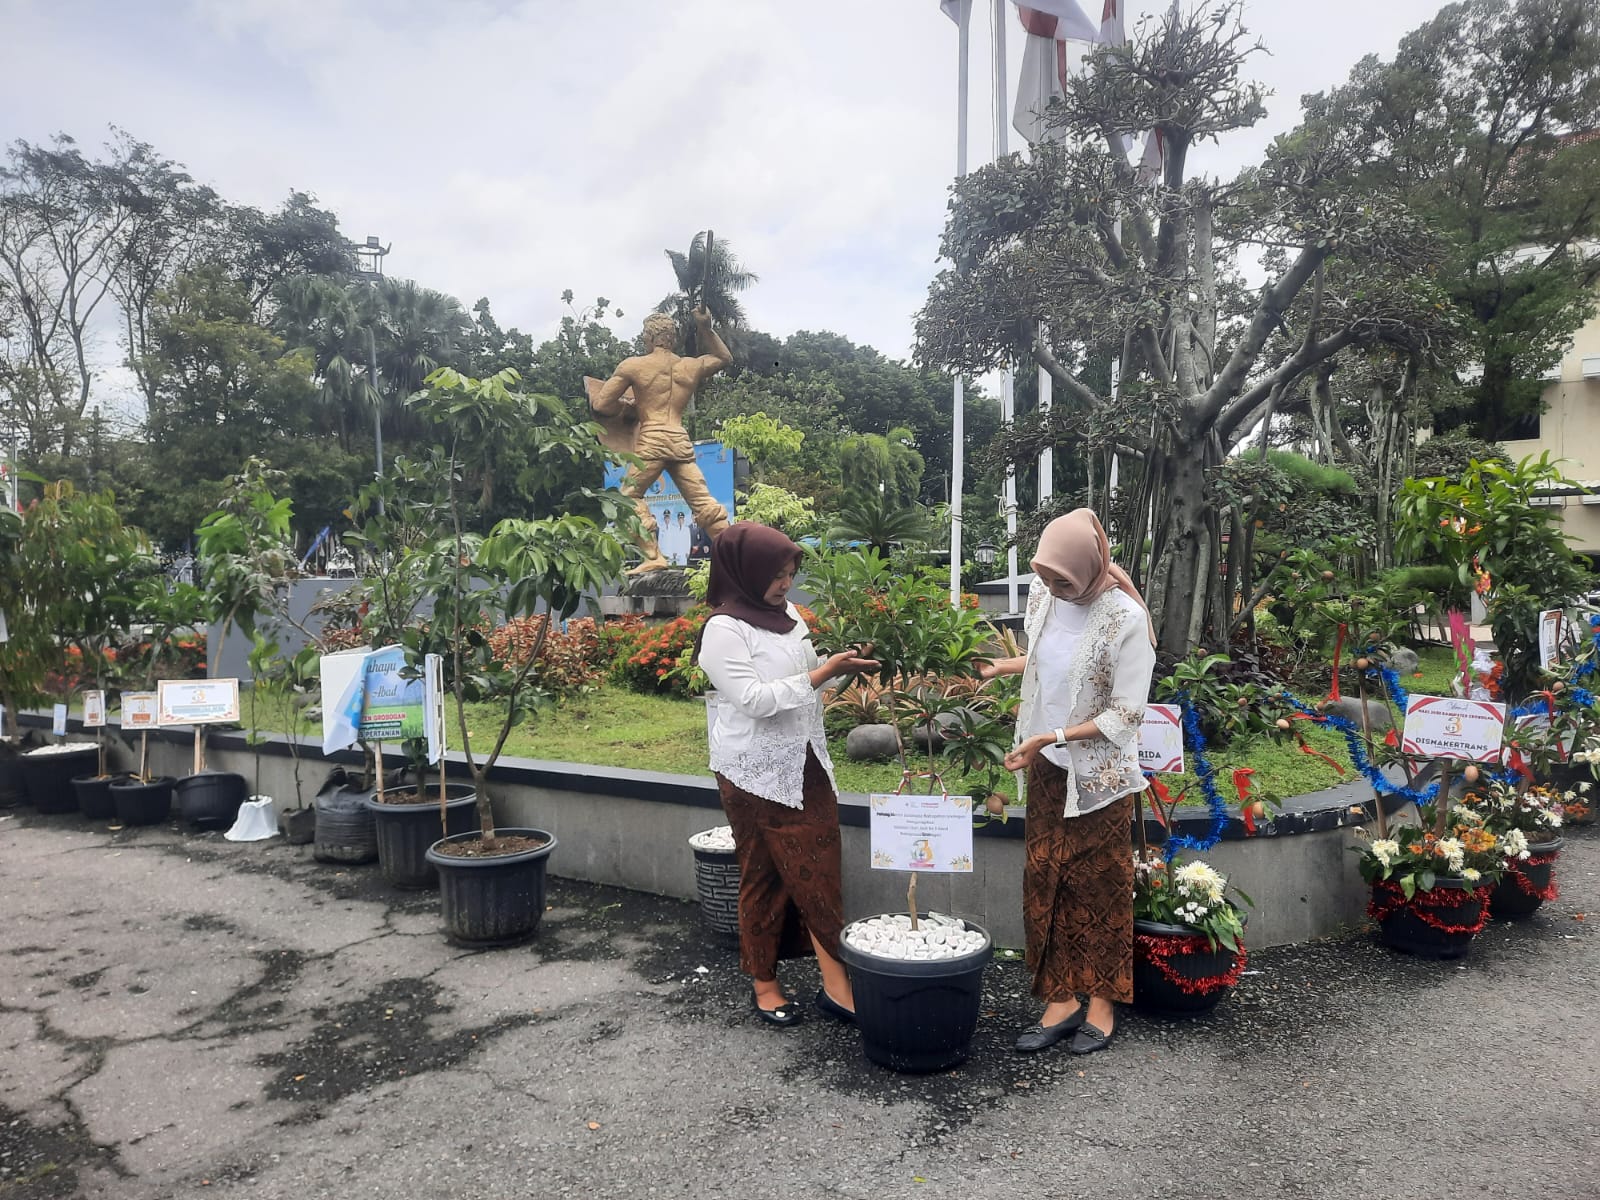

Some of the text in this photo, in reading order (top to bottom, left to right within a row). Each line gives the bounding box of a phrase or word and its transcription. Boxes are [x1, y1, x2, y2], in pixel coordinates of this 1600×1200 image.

[366, 660, 397, 676] ahayu
[365, 729, 400, 738] PERTANIAN
[1138, 750, 1161, 759] RIDA
